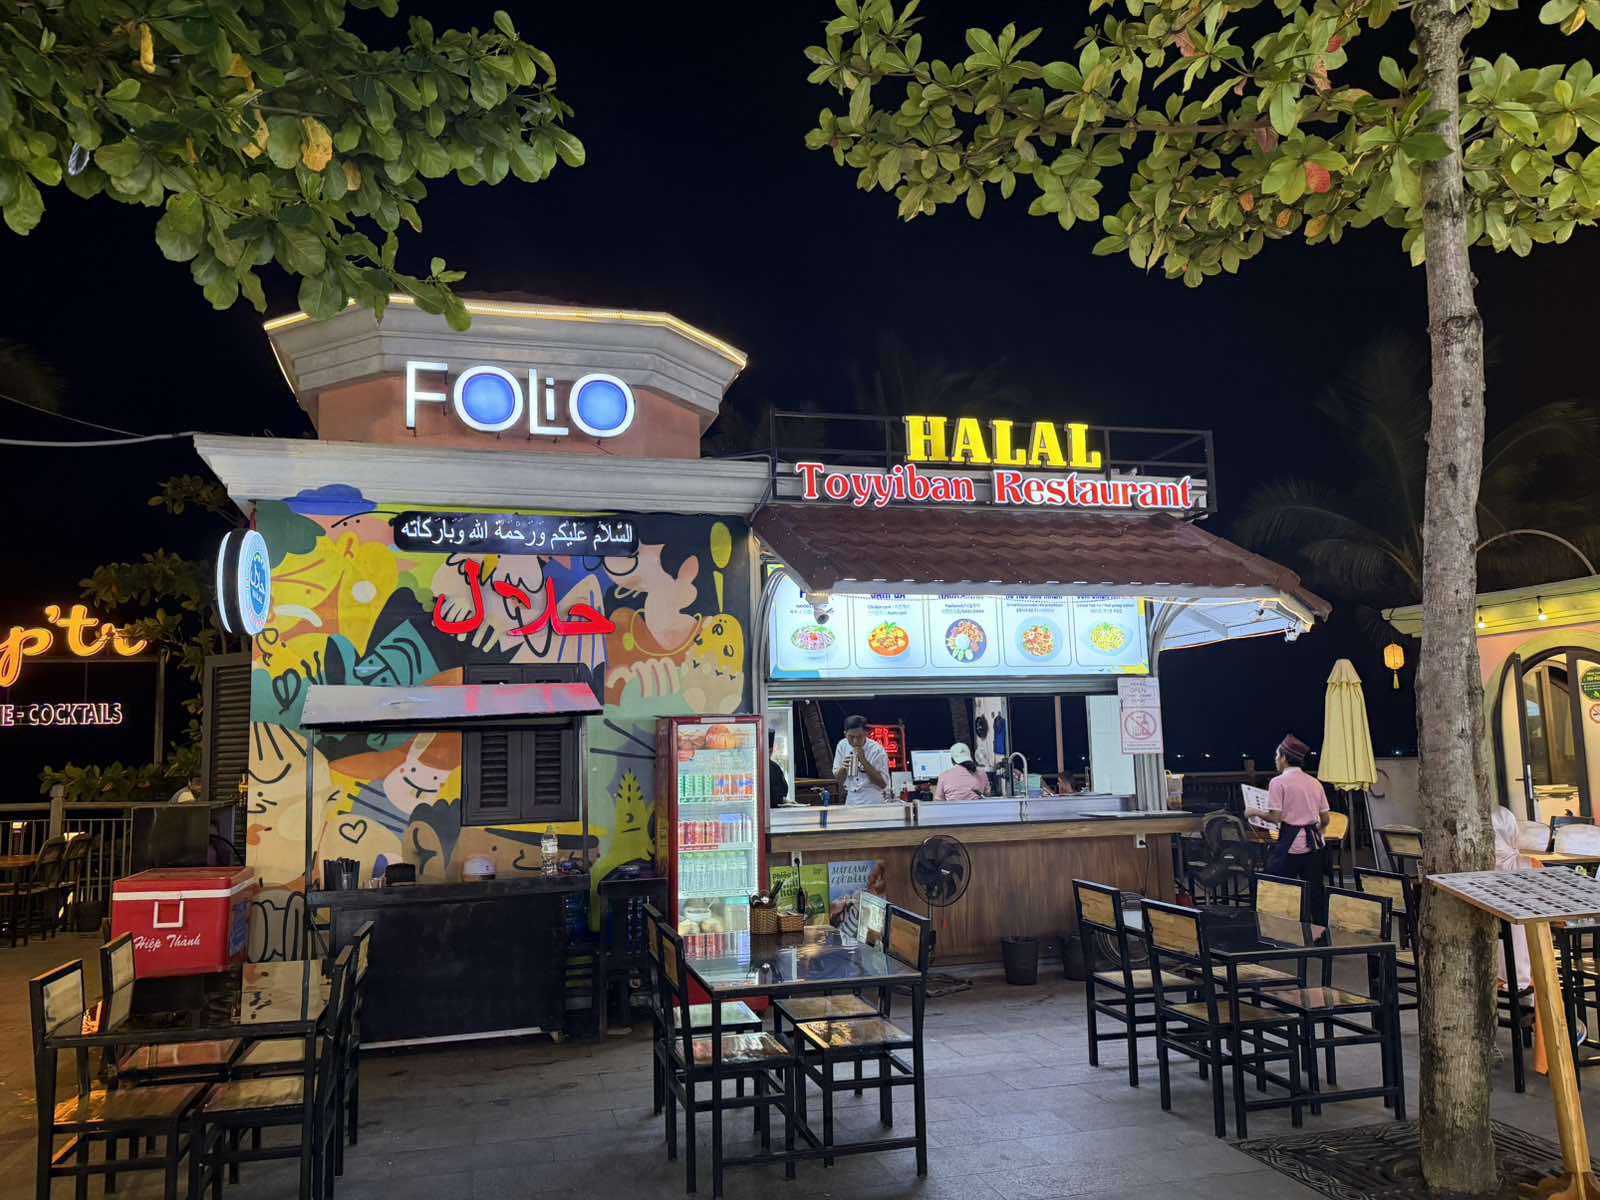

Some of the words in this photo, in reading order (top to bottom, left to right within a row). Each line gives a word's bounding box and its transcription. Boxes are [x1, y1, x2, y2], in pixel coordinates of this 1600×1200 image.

[904, 415, 1102, 470] HALAL
[795, 461, 977, 508] Toyyiban
[989, 469, 1194, 509] Restaurant
